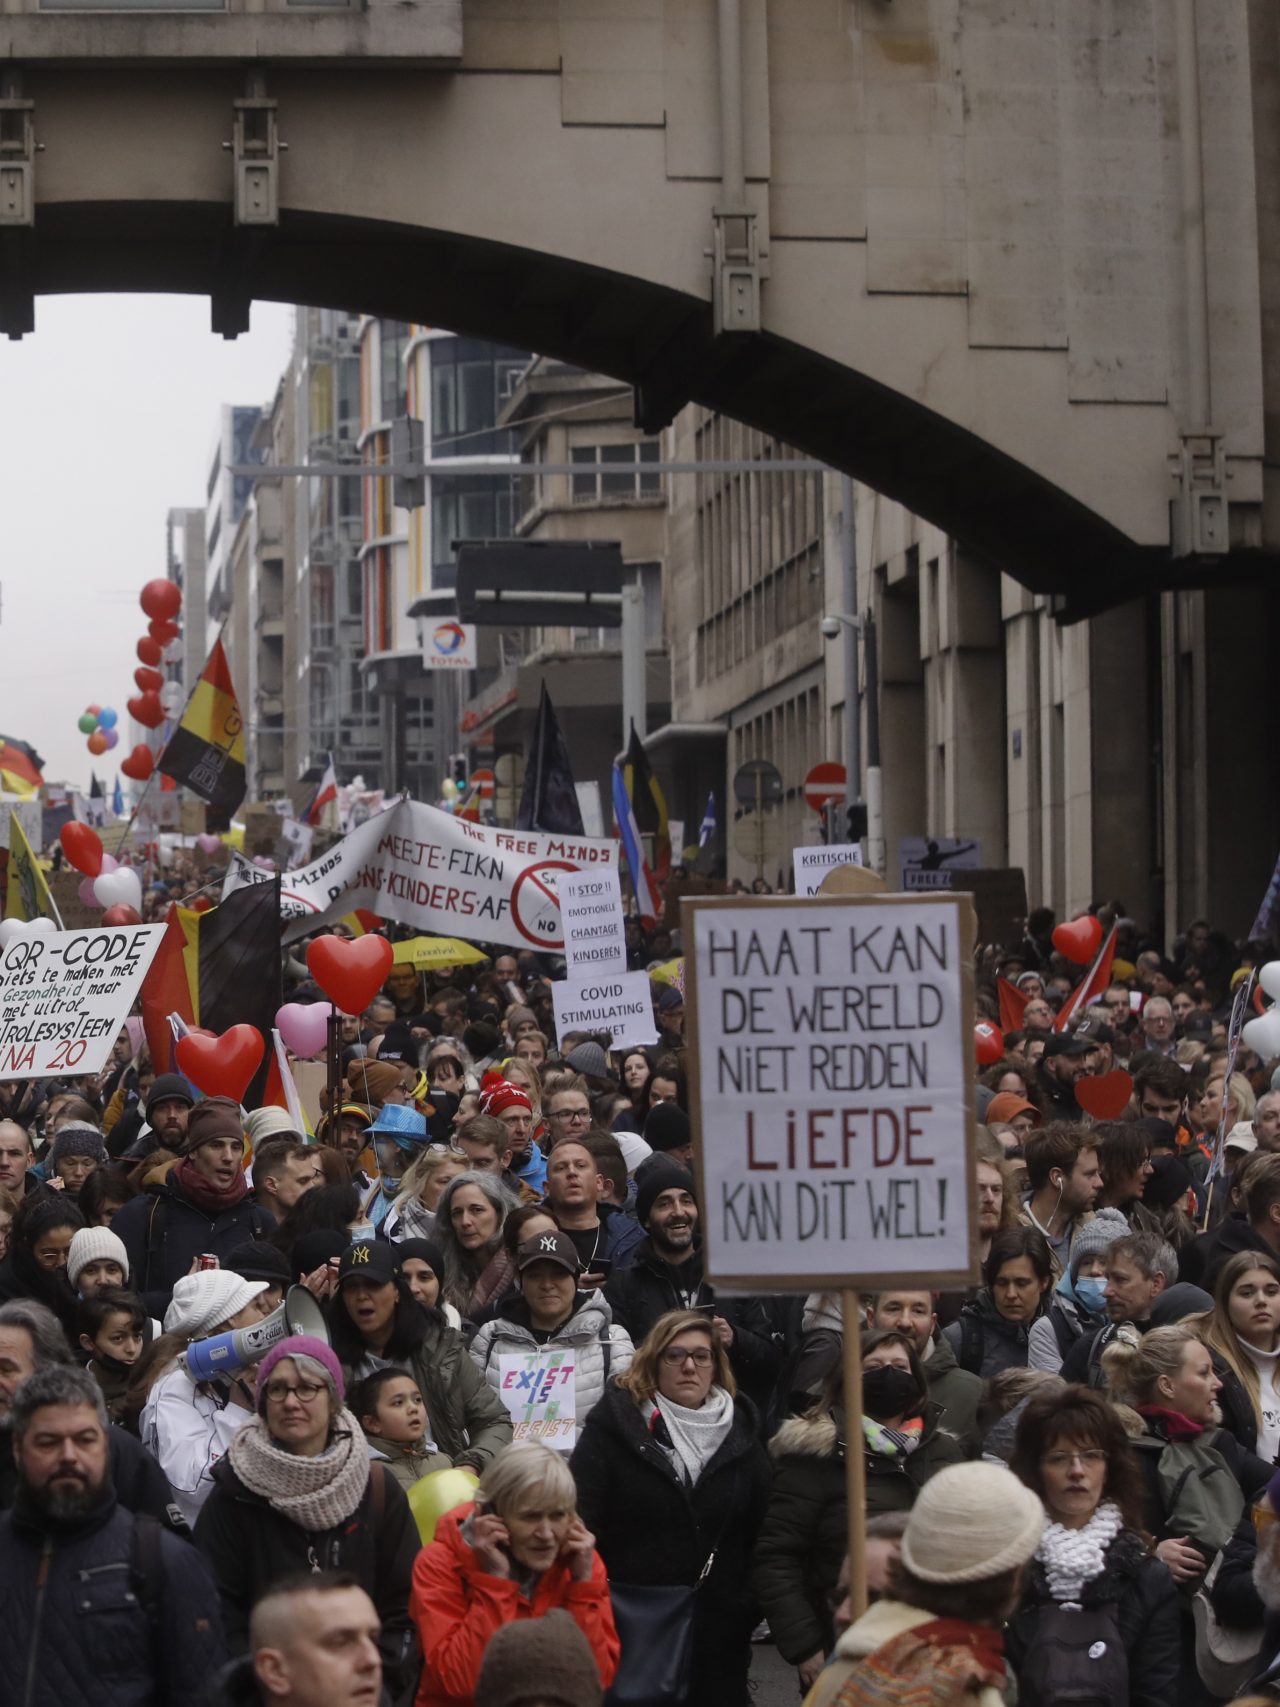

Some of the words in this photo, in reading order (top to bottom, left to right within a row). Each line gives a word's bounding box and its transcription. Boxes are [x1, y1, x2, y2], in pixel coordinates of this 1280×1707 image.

[428, 656, 471, 666] TOTAL
[456, 820, 485, 843] THE
[495, 833, 537, 856] FREE
[547, 839, 610, 863] MINDS
[802, 851, 859, 866] KRITISCHE
[292, 851, 343, 889] MINDS
[578, 883, 603, 897] STOP
[569, 902, 617, 918] EMOTIONELE
[538, 918, 556, 934] NO
[571, 923, 619, 940] CHANTAGE
[572, 945, 621, 963] KINDEREN
[708, 927, 832, 977] HAAT
[850, 923, 949, 974] KAN
[42, 967, 57, 983] te
[110, 960, 138, 977] met
[3, 981, 84, 1002] Gezondheid
[87, 981, 121, 995] maar
[581, 984, 623, 1001] COVID
[2, 1003, 29, 1019] met
[561, 1001, 644, 1024] STIMULATING
[722, 988, 775, 1035] DE
[786, 983, 944, 1034] WERELD
[809, 1040, 929, 1092] REDDEN
[722, 1180, 782, 1244] KAN
[866, 1178, 949, 1240] WEL!
[502, 1365, 575, 1390] EXIST
[527, 1385, 552, 1404] IS
